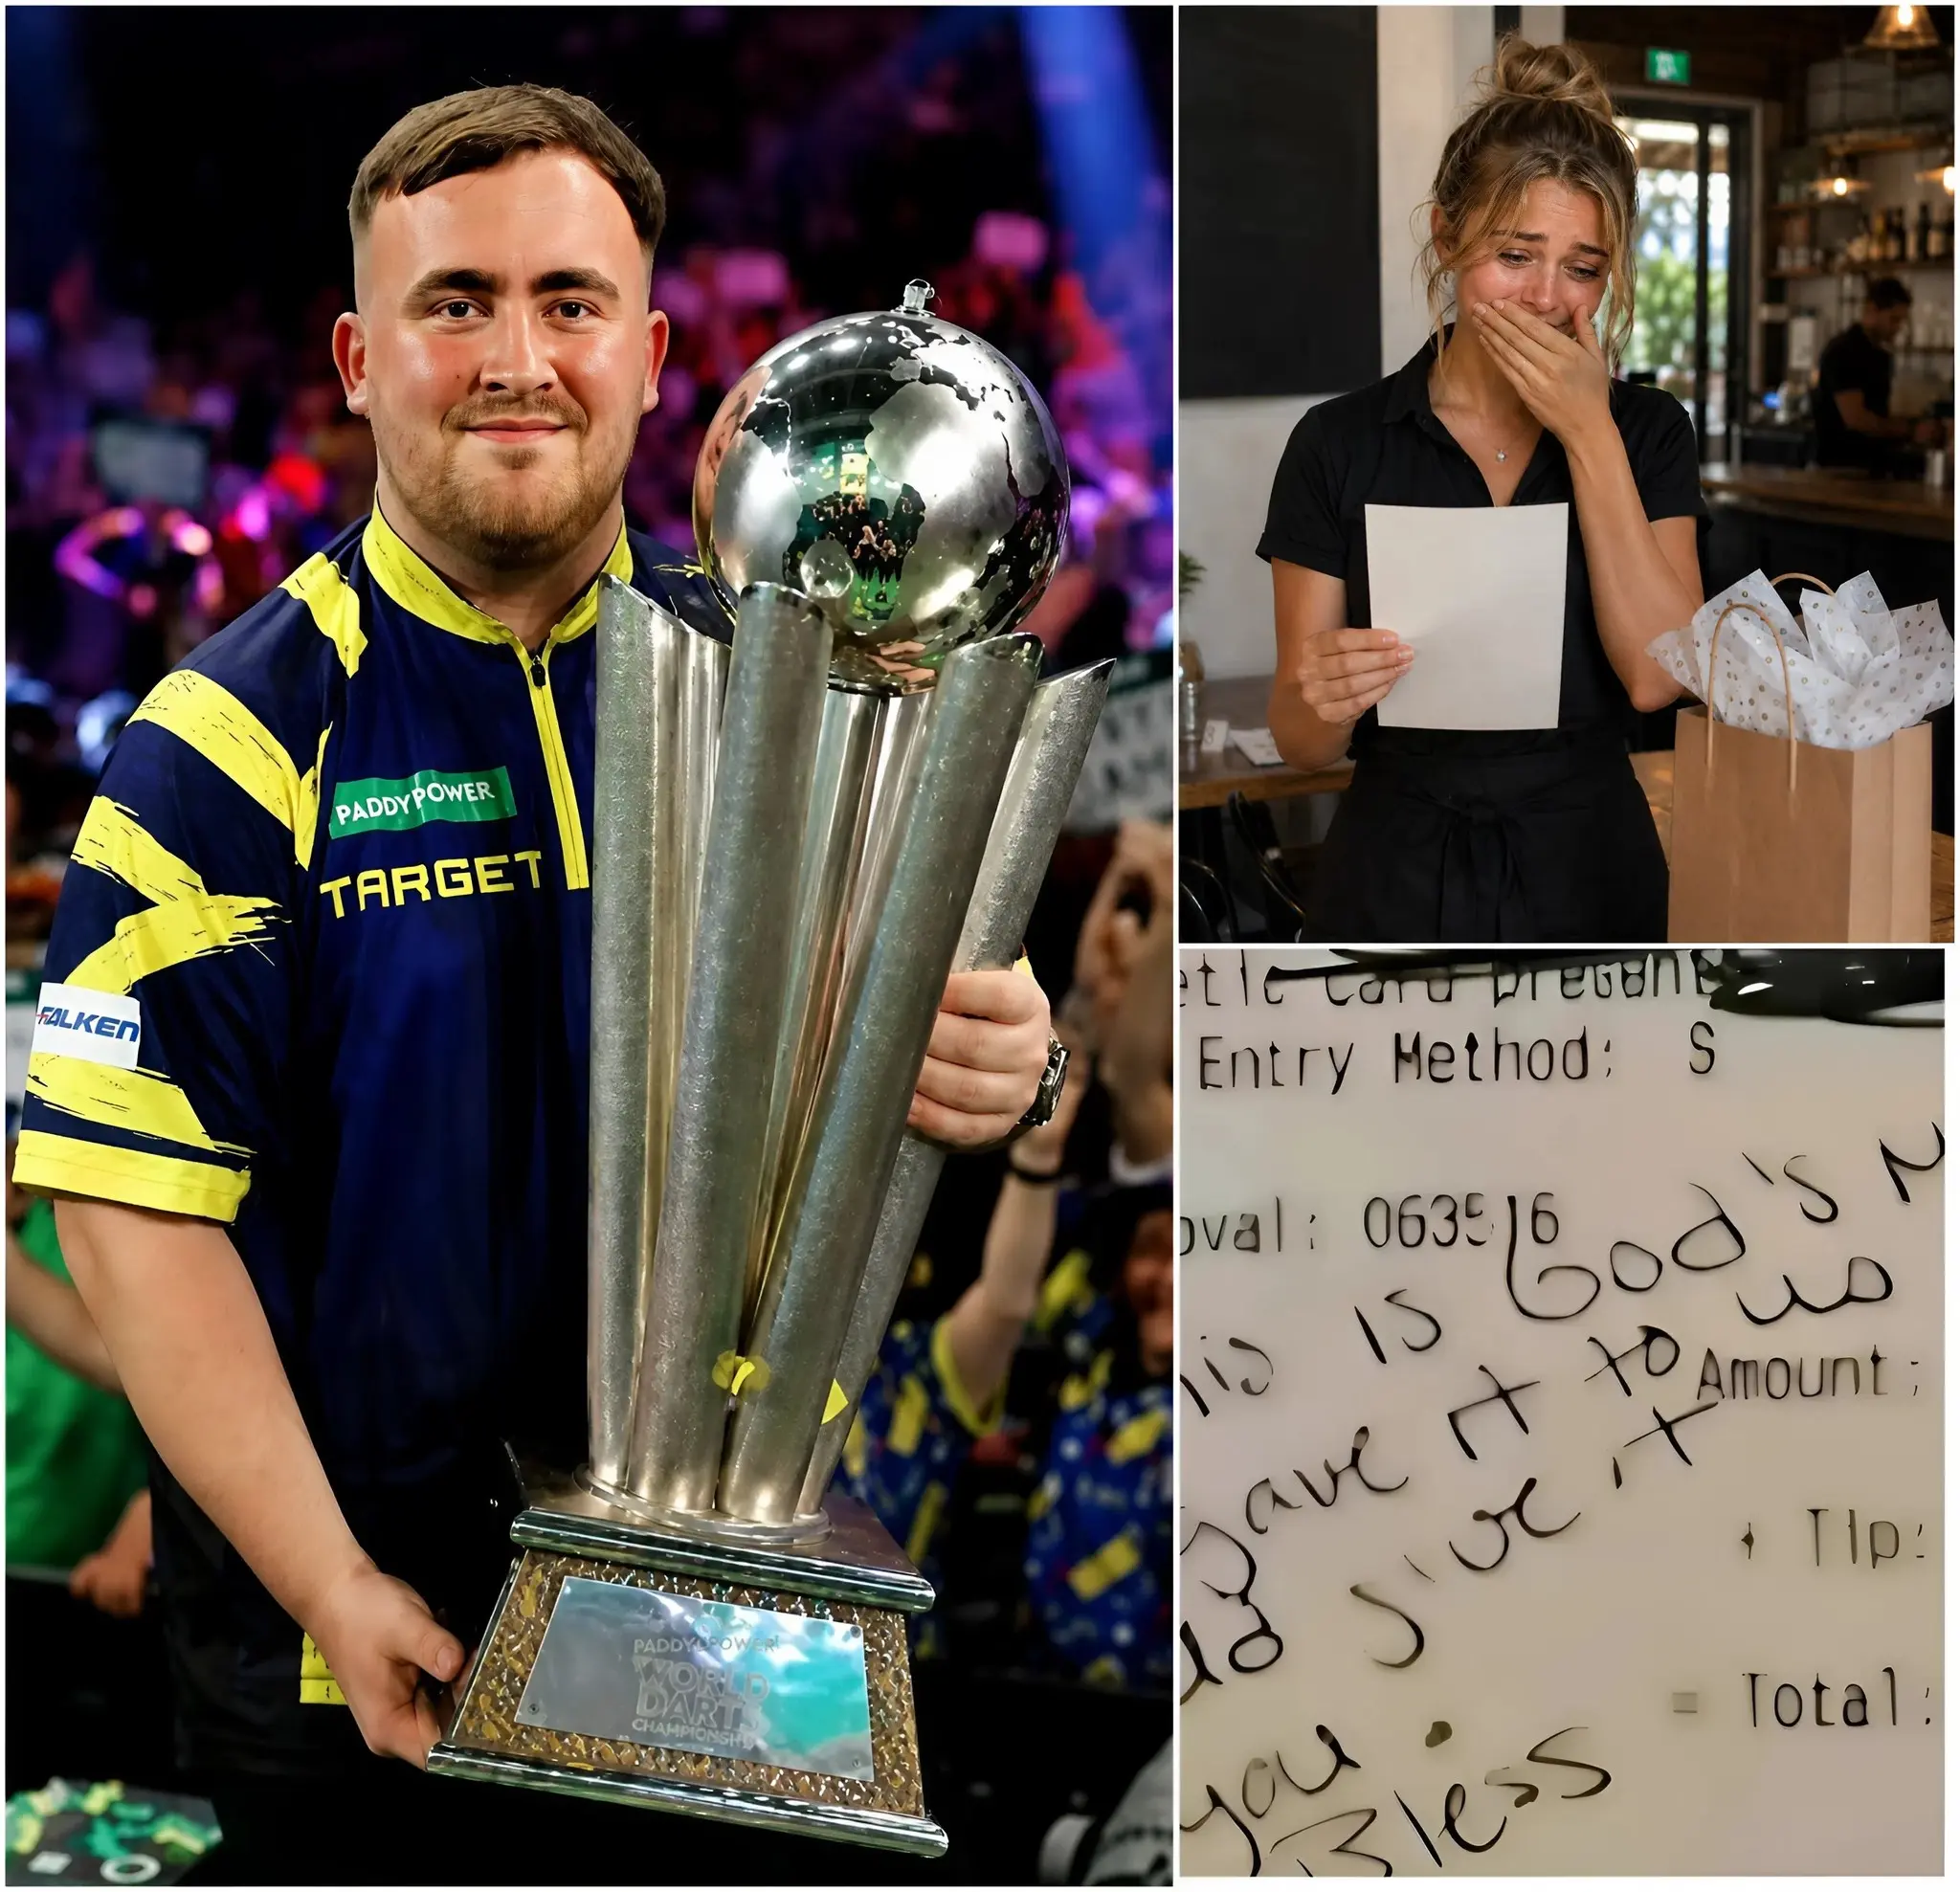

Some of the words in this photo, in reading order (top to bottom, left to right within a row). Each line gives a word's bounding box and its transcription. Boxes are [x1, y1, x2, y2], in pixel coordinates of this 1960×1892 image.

[319, 850, 542, 919] TARGET
[37, 1006, 141, 1043] FALKEN
[1199, 1035, 1355, 1096] Entry
[1393, 1025, 1612, 1084] Method:
[1688, 1020, 1716, 1075] S
[1584, 1324, 1682, 1397] to
[1696, 1344, 1920, 1401] Amount:
[632, 1654, 771, 1703] WORLD
[1740, 1665, 1932, 1728] Total:
[1269, 1726, 1614, 1877] Bless
